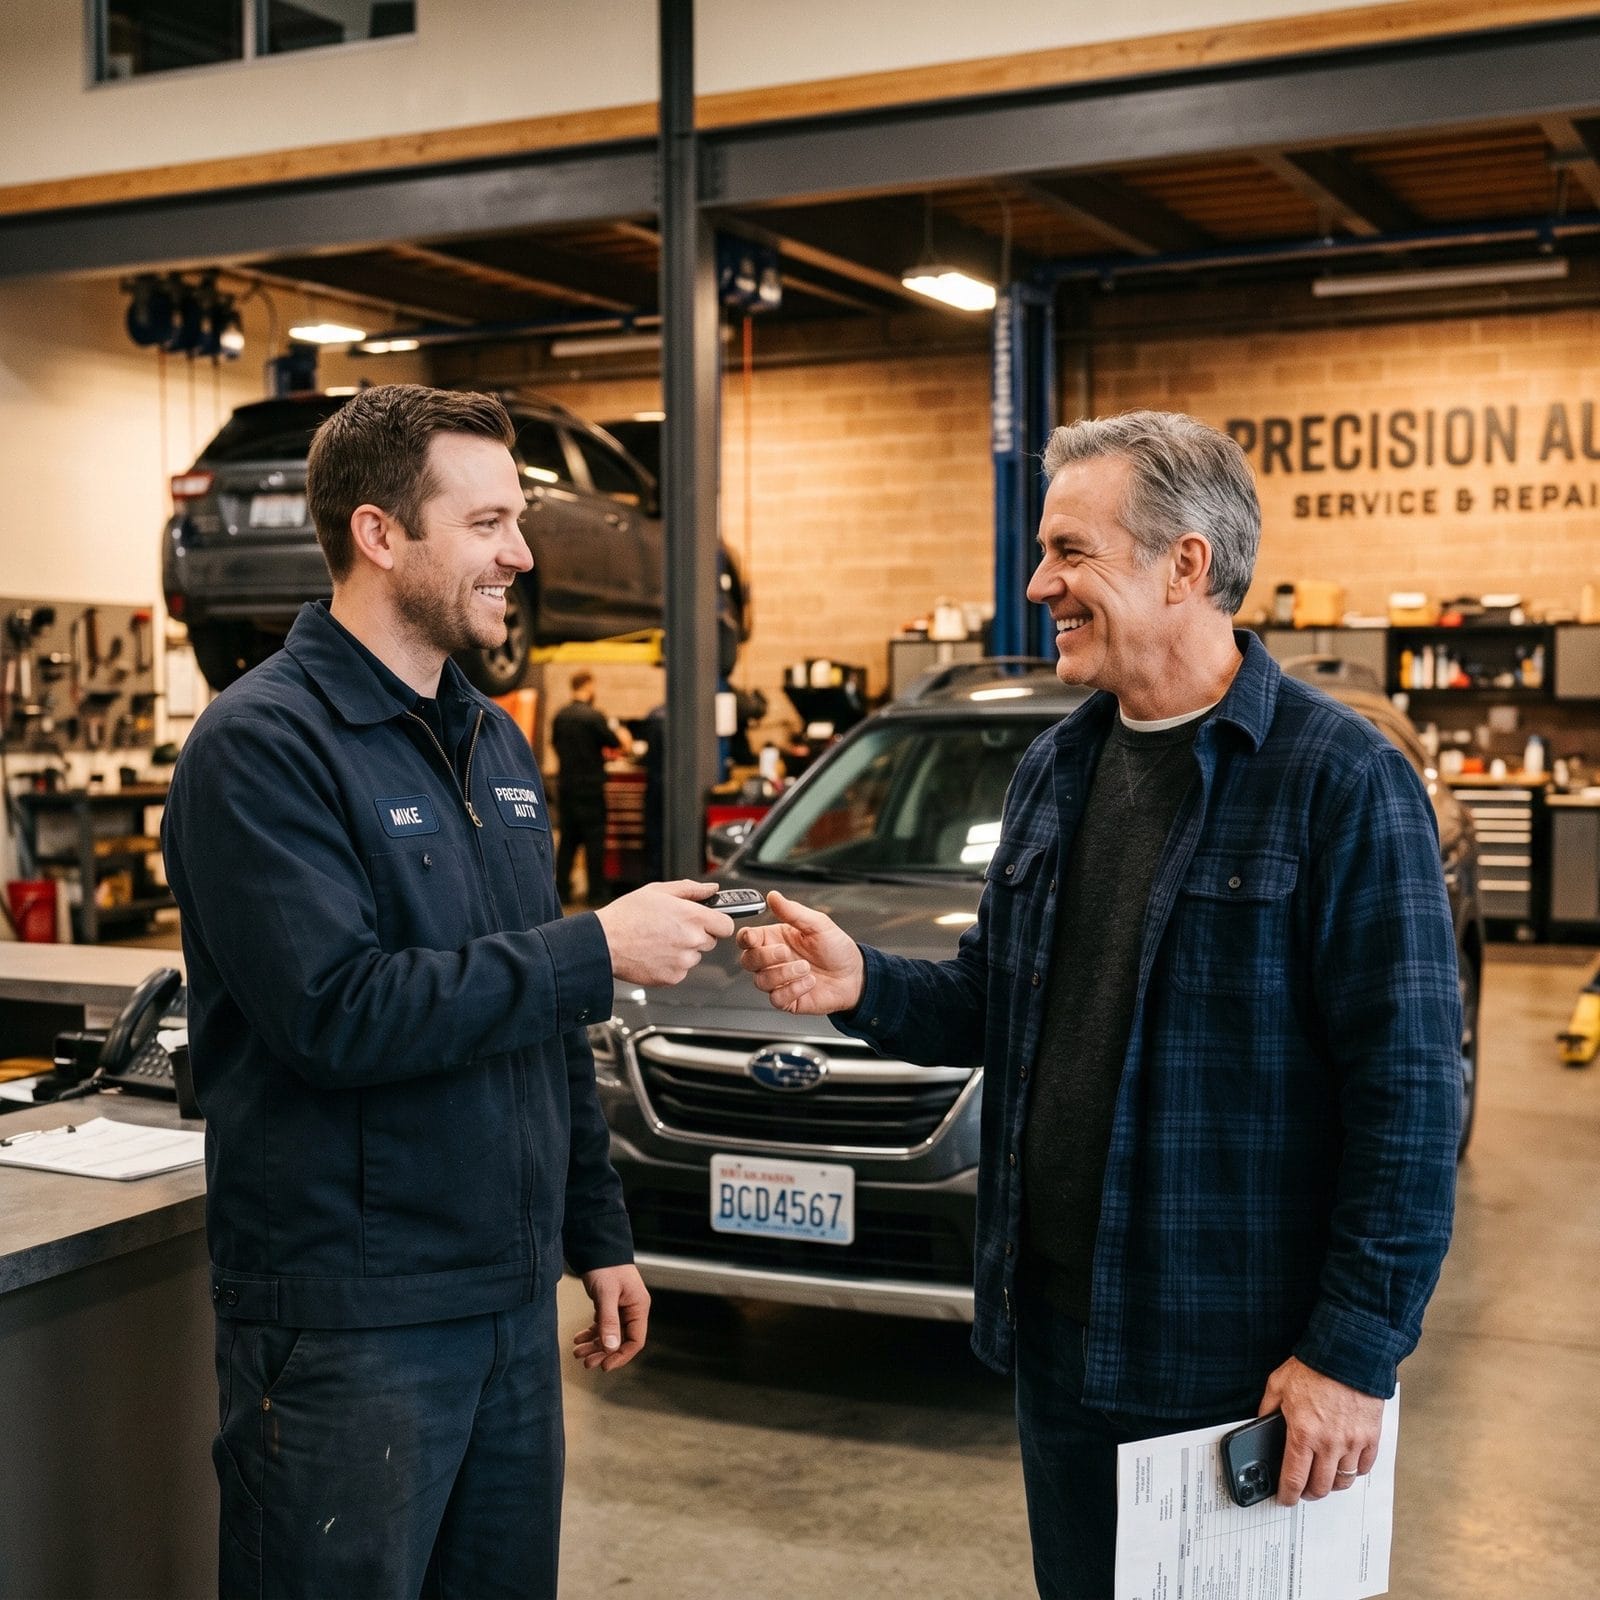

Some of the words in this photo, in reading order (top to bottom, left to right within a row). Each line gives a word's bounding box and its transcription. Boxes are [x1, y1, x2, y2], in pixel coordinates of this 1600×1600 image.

[1294, 488, 1438, 518] SERVICE
[1455, 487, 1476, 513] &
[389, 806, 423, 827] MIKE
[720, 1183, 843, 1230] BCD4567
